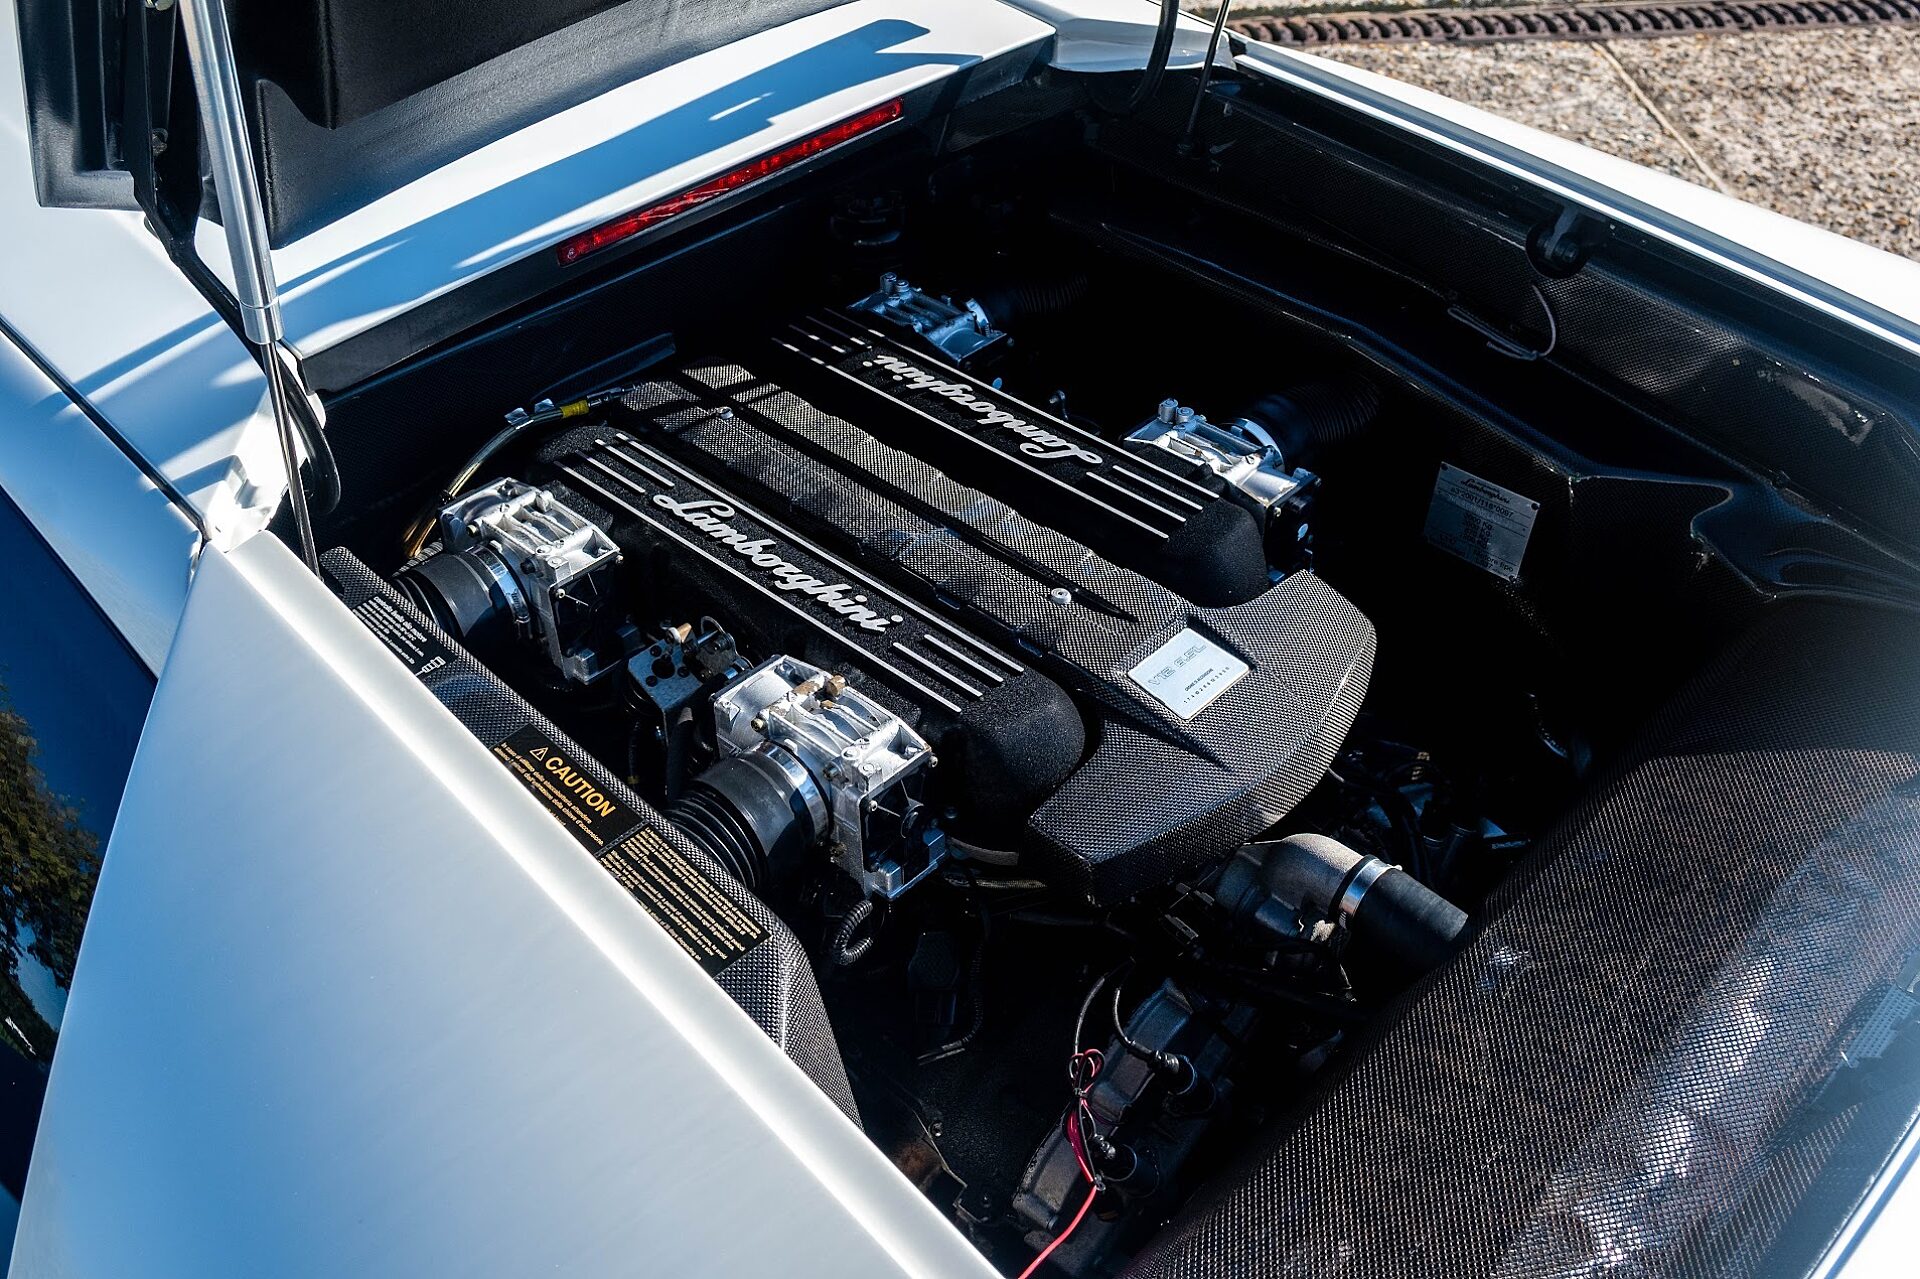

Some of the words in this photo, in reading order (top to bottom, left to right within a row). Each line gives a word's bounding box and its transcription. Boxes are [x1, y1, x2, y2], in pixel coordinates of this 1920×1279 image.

[863, 354, 1102, 464] Lamborghini
[653, 495, 903, 635] Lamborghini
[544, 757, 617, 818] CAUTION
